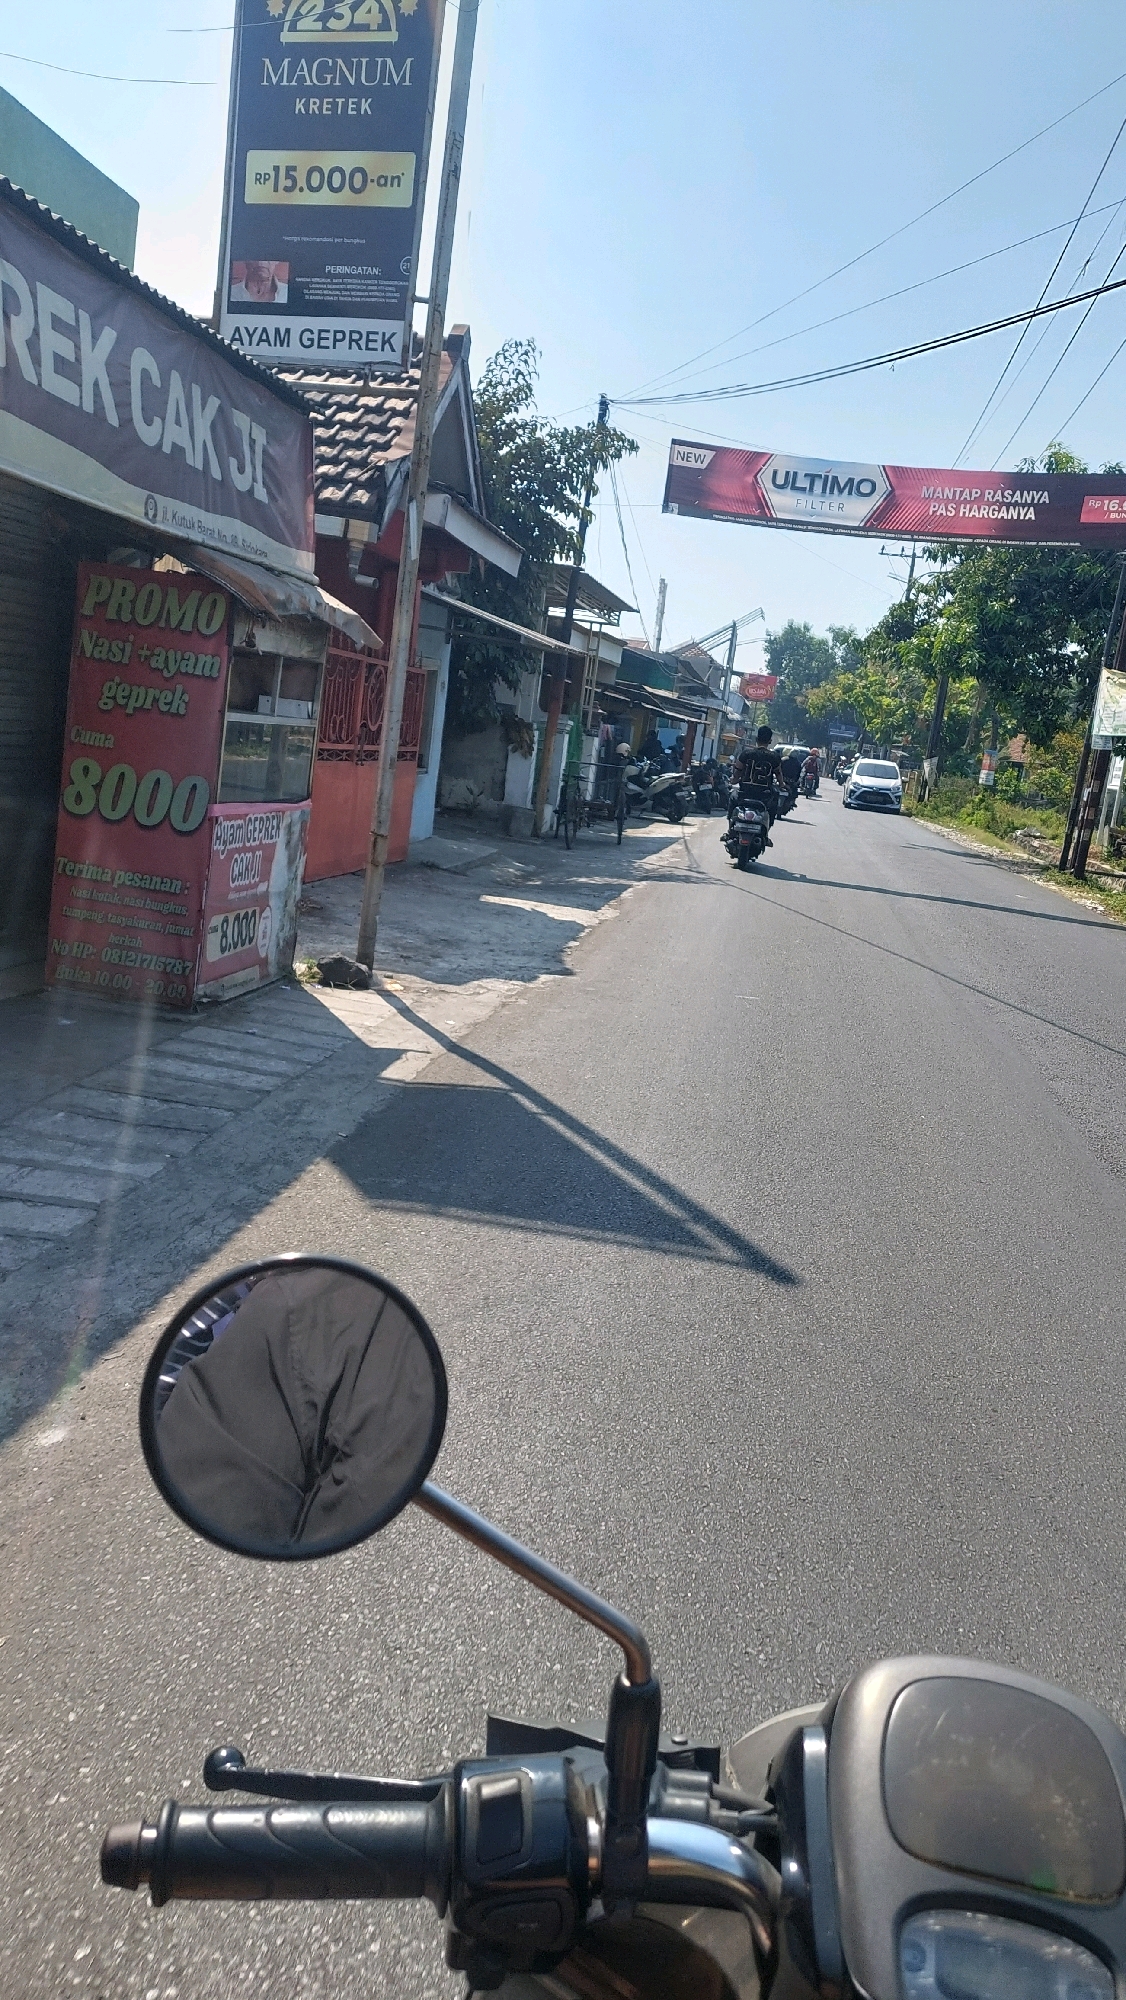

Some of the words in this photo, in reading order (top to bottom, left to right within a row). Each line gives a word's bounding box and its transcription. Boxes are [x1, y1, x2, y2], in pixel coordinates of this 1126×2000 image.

[297, 0, 382, 31] 234
[261, 57, 414, 87] MAGNUM
[295, 97, 373, 116] KRETEK
[325, 265, 381, 275] PERINGATAN:
[230, 326, 291, 349] AYAM
[298, 329, 397, 353] GEPREK
[130, 347, 222, 481] CAK
[228, 408, 268, 504] JI
[675, 450, 707, 465] NEW
[796, 498, 845, 513] FILTER
[921, 485, 981, 501] MANTAP
[983, 488, 1050, 505] RASANYA
[1088, 499, 1102, 509] Rp
[171, 511, 195, 531] Kutuk
[197, 519, 215, 536] Barat
[929, 502, 956, 517] PAS
[959, 502, 1036, 521] HARGANYA
[80, 574, 227, 636] PROMO
[79, 629, 135, 664] Nasi
[98, 676, 189, 715] geprek
[70, 725, 115, 749] Cuma
[62, 756, 210, 832] 8000
[213, 817, 245, 858] Ayam
[57, 857, 112, 882] Terima
[230, 852, 252, 886] CAK
[69, 886, 91, 899] Nasi
[123, 896, 144, 909] nasi
[145, 898, 189, 917] bungkus,
[108, 932, 143, 947] berkah
[164, 919, 194, 936] jumat
[51, 938, 69, 956] No
